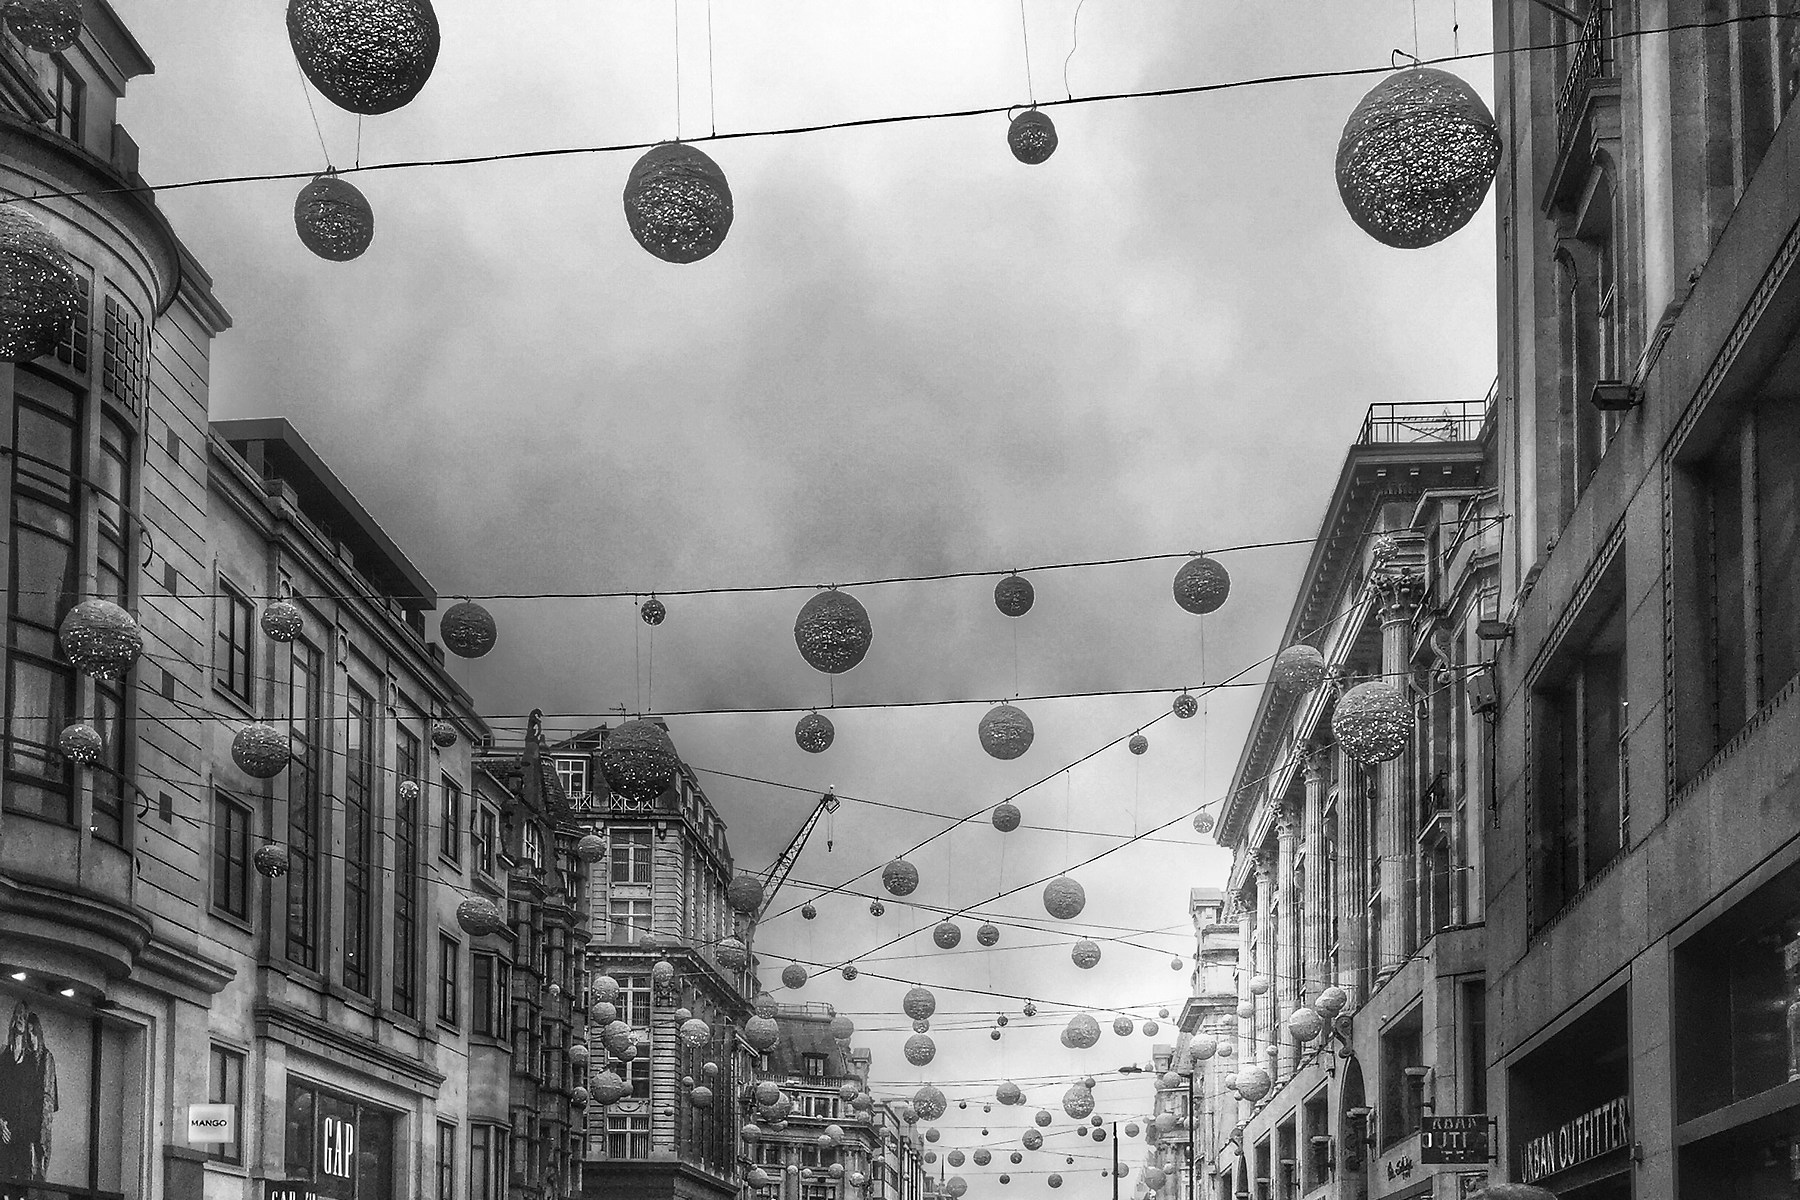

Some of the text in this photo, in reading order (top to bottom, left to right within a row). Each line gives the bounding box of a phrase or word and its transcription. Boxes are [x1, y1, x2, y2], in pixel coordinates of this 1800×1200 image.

[191, 1119, 227, 1128] MANGO
[324, 1117, 354, 1178] GAP
[1519, 1131, 1555, 1183] URBAN
